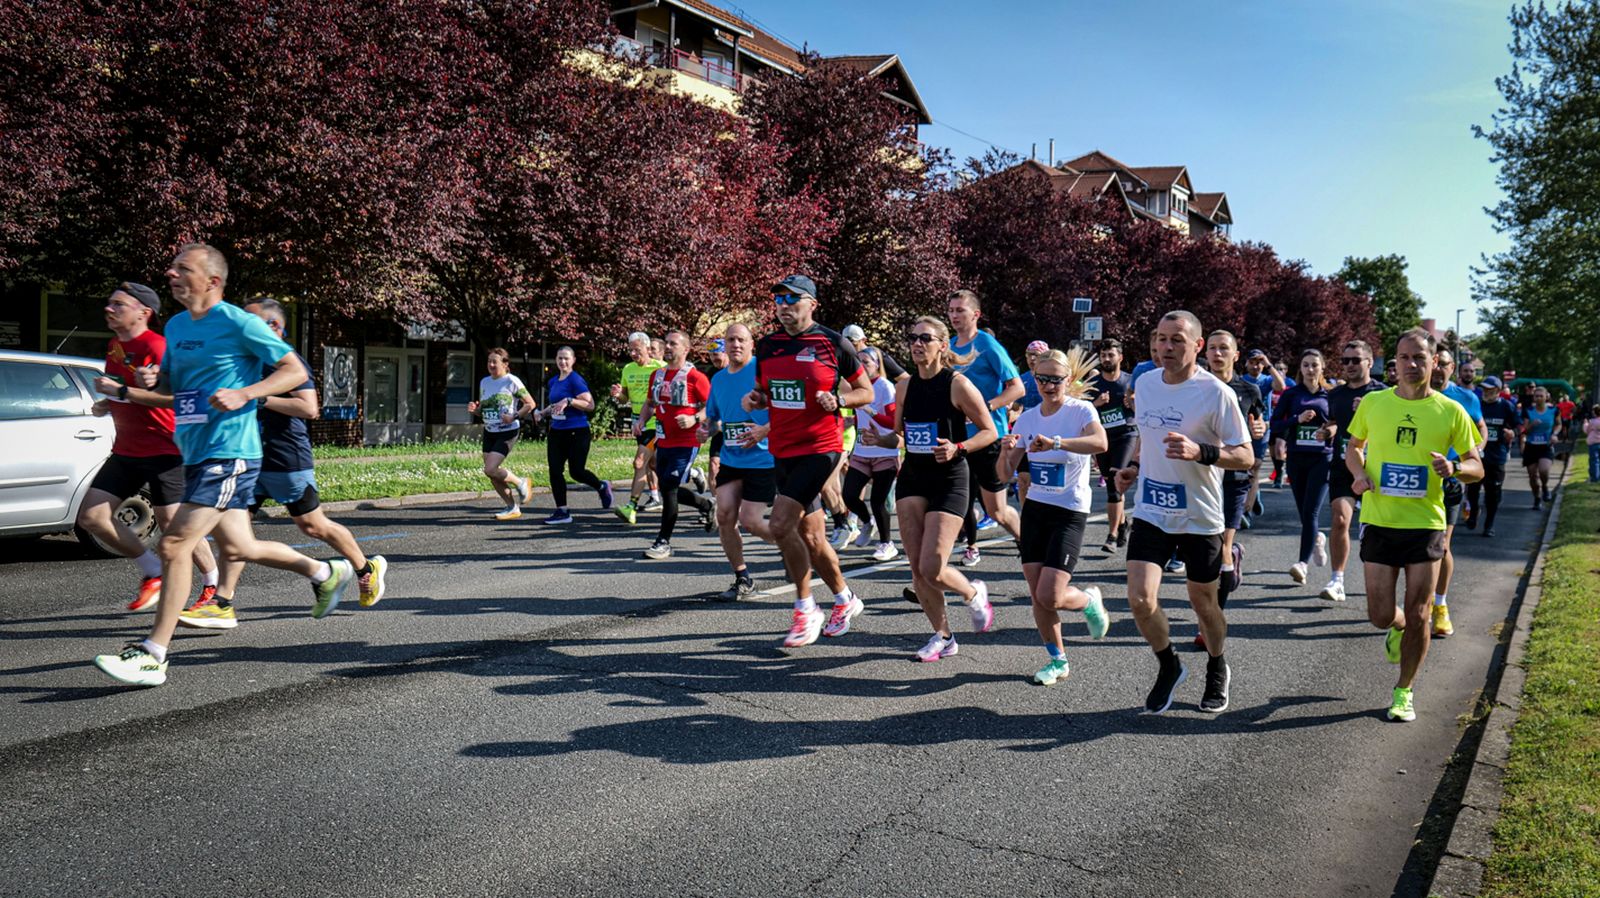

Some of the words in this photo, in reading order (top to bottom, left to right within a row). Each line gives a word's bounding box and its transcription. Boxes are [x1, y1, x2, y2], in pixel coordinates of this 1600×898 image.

[770, 386, 801, 401] 1181
[179, 399, 196, 414] 56
[1101, 411, 1124, 423] 1004
[907, 431, 931, 445] 523
[1298, 430, 1317, 440] 114
[1039, 470, 1049, 485] 5
[1386, 472, 1420, 489] 325
[1149, 489, 1178, 508] 138
